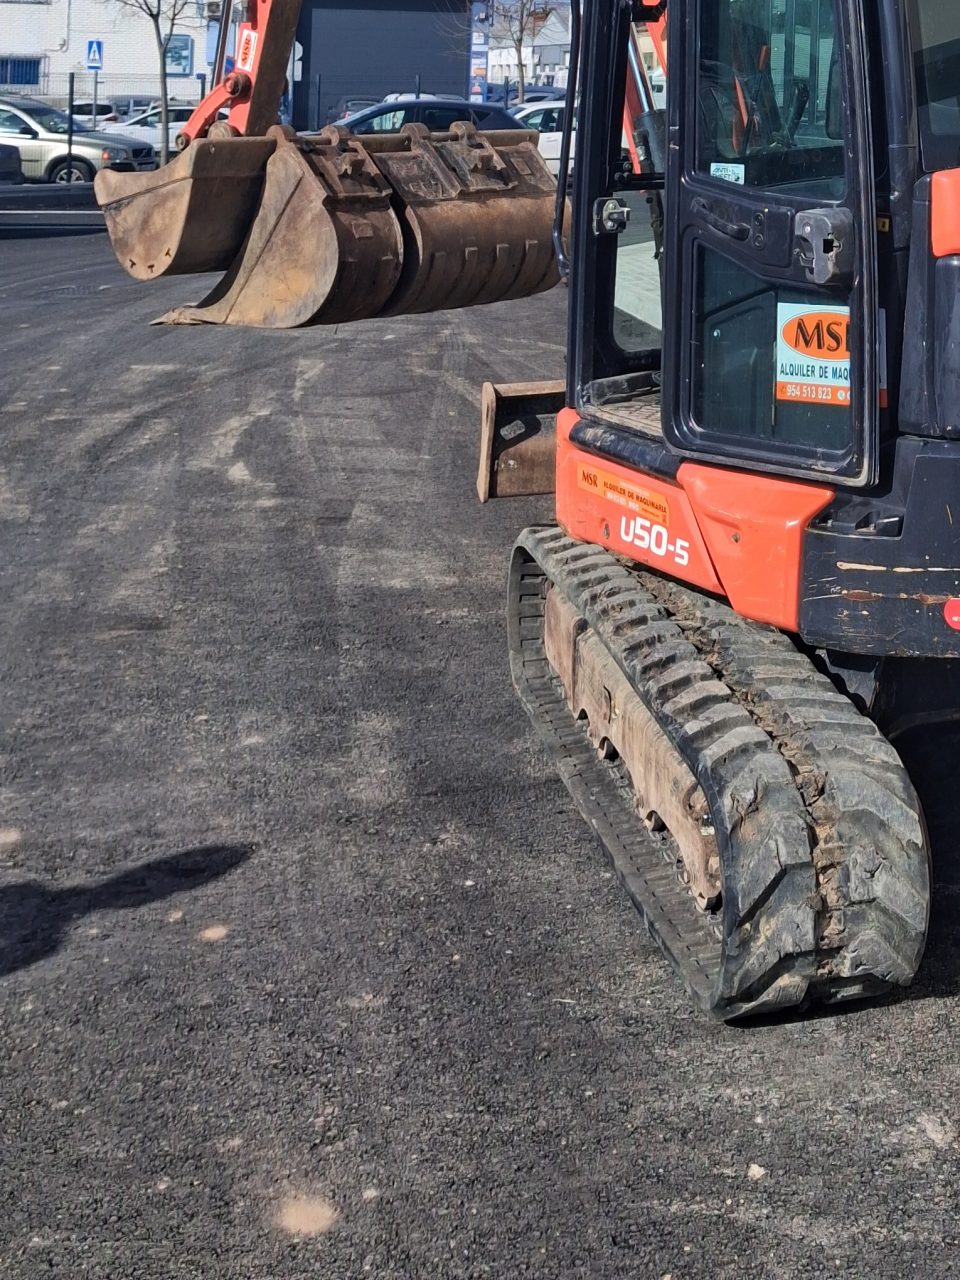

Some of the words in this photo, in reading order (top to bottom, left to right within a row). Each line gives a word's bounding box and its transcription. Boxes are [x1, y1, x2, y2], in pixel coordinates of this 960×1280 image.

[780, 363, 815, 378] ALQUILER
[819, 366, 829, 379] DE
[832, 366, 851, 380] MAQ
[786, 384, 800, 397] 954
[802, 386, 816, 398] 513
[818, 387, 832, 400] 823
[582, 470, 598, 488] MSR
[620, 516, 690, 566] U50-5
